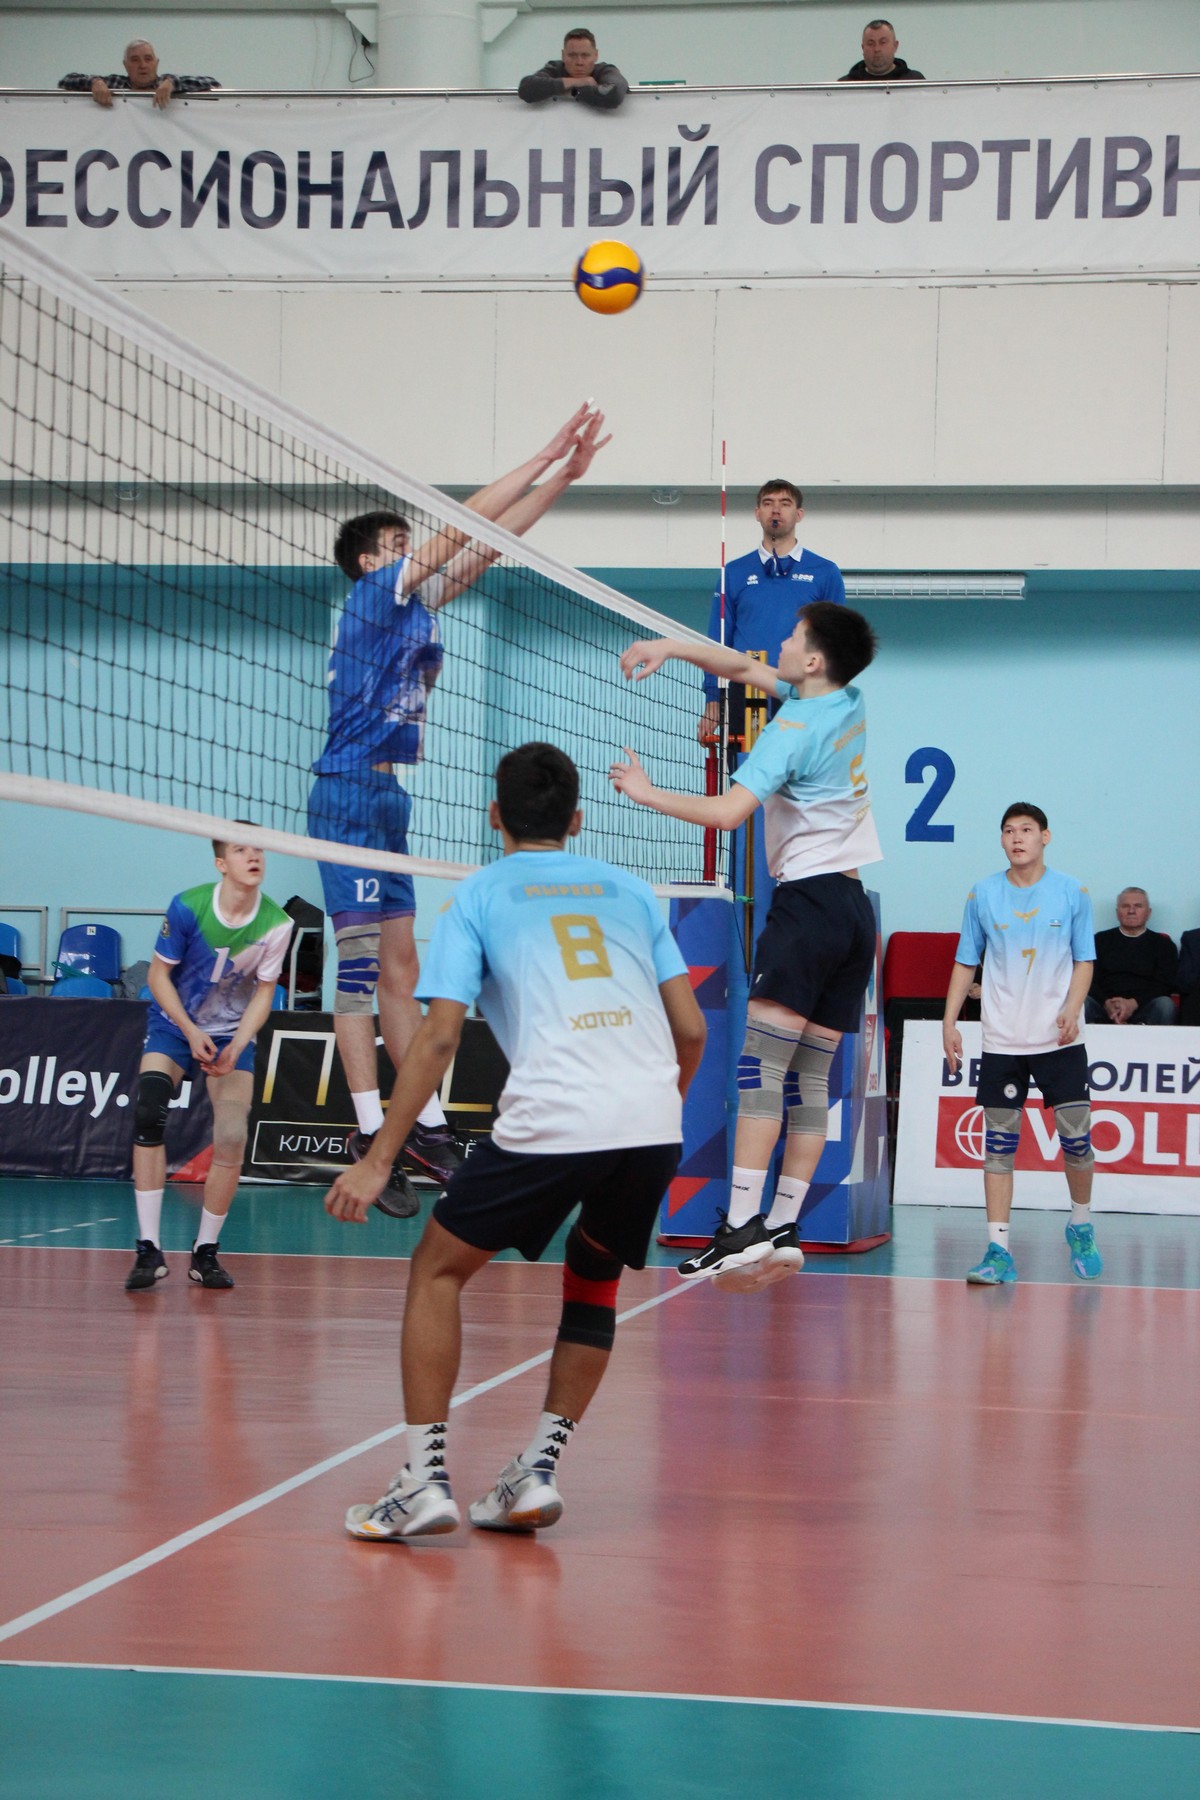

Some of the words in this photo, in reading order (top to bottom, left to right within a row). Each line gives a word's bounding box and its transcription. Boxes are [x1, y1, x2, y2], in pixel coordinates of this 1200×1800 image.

[754, 134, 1200, 225] СПОРТИВН
[904, 746, 956, 842] 2
[354, 878, 380, 902] 12
[210, 947, 230, 983] 1
[551, 914, 613, 981] 8
[1022, 948, 1037, 975] 7
[569, 1005, 632, 1031] ХОТОЙ
[0, 1056, 192, 1118] olley.u
[279, 1134, 349, 1155] КЛУБ
